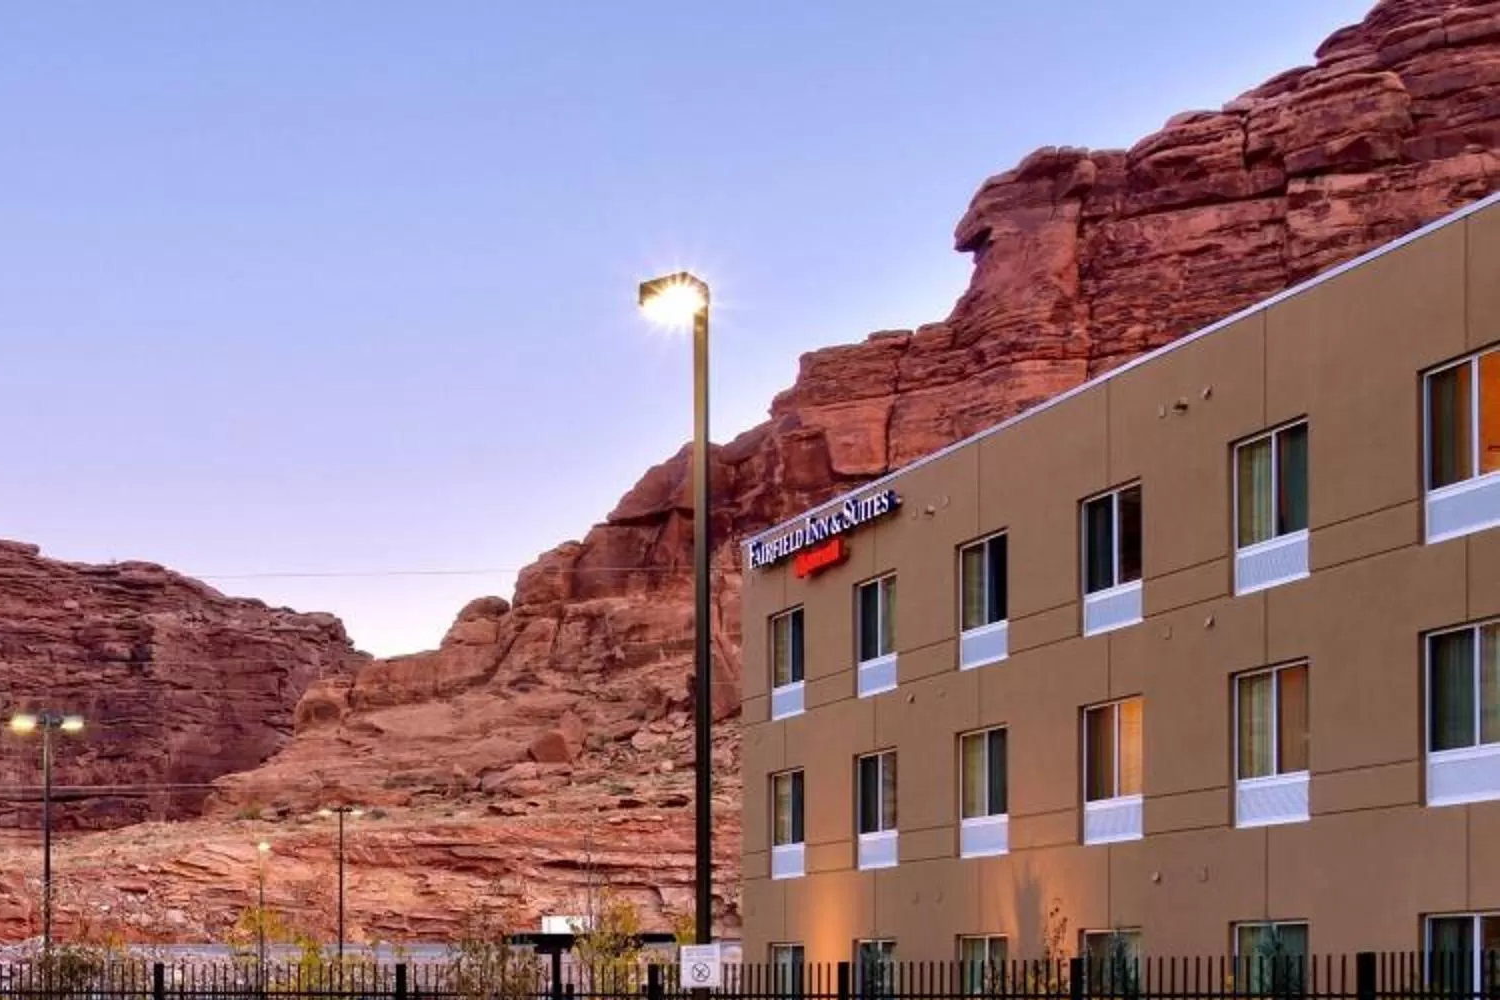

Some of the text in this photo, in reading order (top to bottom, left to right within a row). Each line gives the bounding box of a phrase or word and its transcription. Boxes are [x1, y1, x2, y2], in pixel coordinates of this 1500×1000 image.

[749, 528, 804, 570] FAIRFIELD
[804, 516, 830, 546] INN
[842, 489, 891, 529] SUITES
